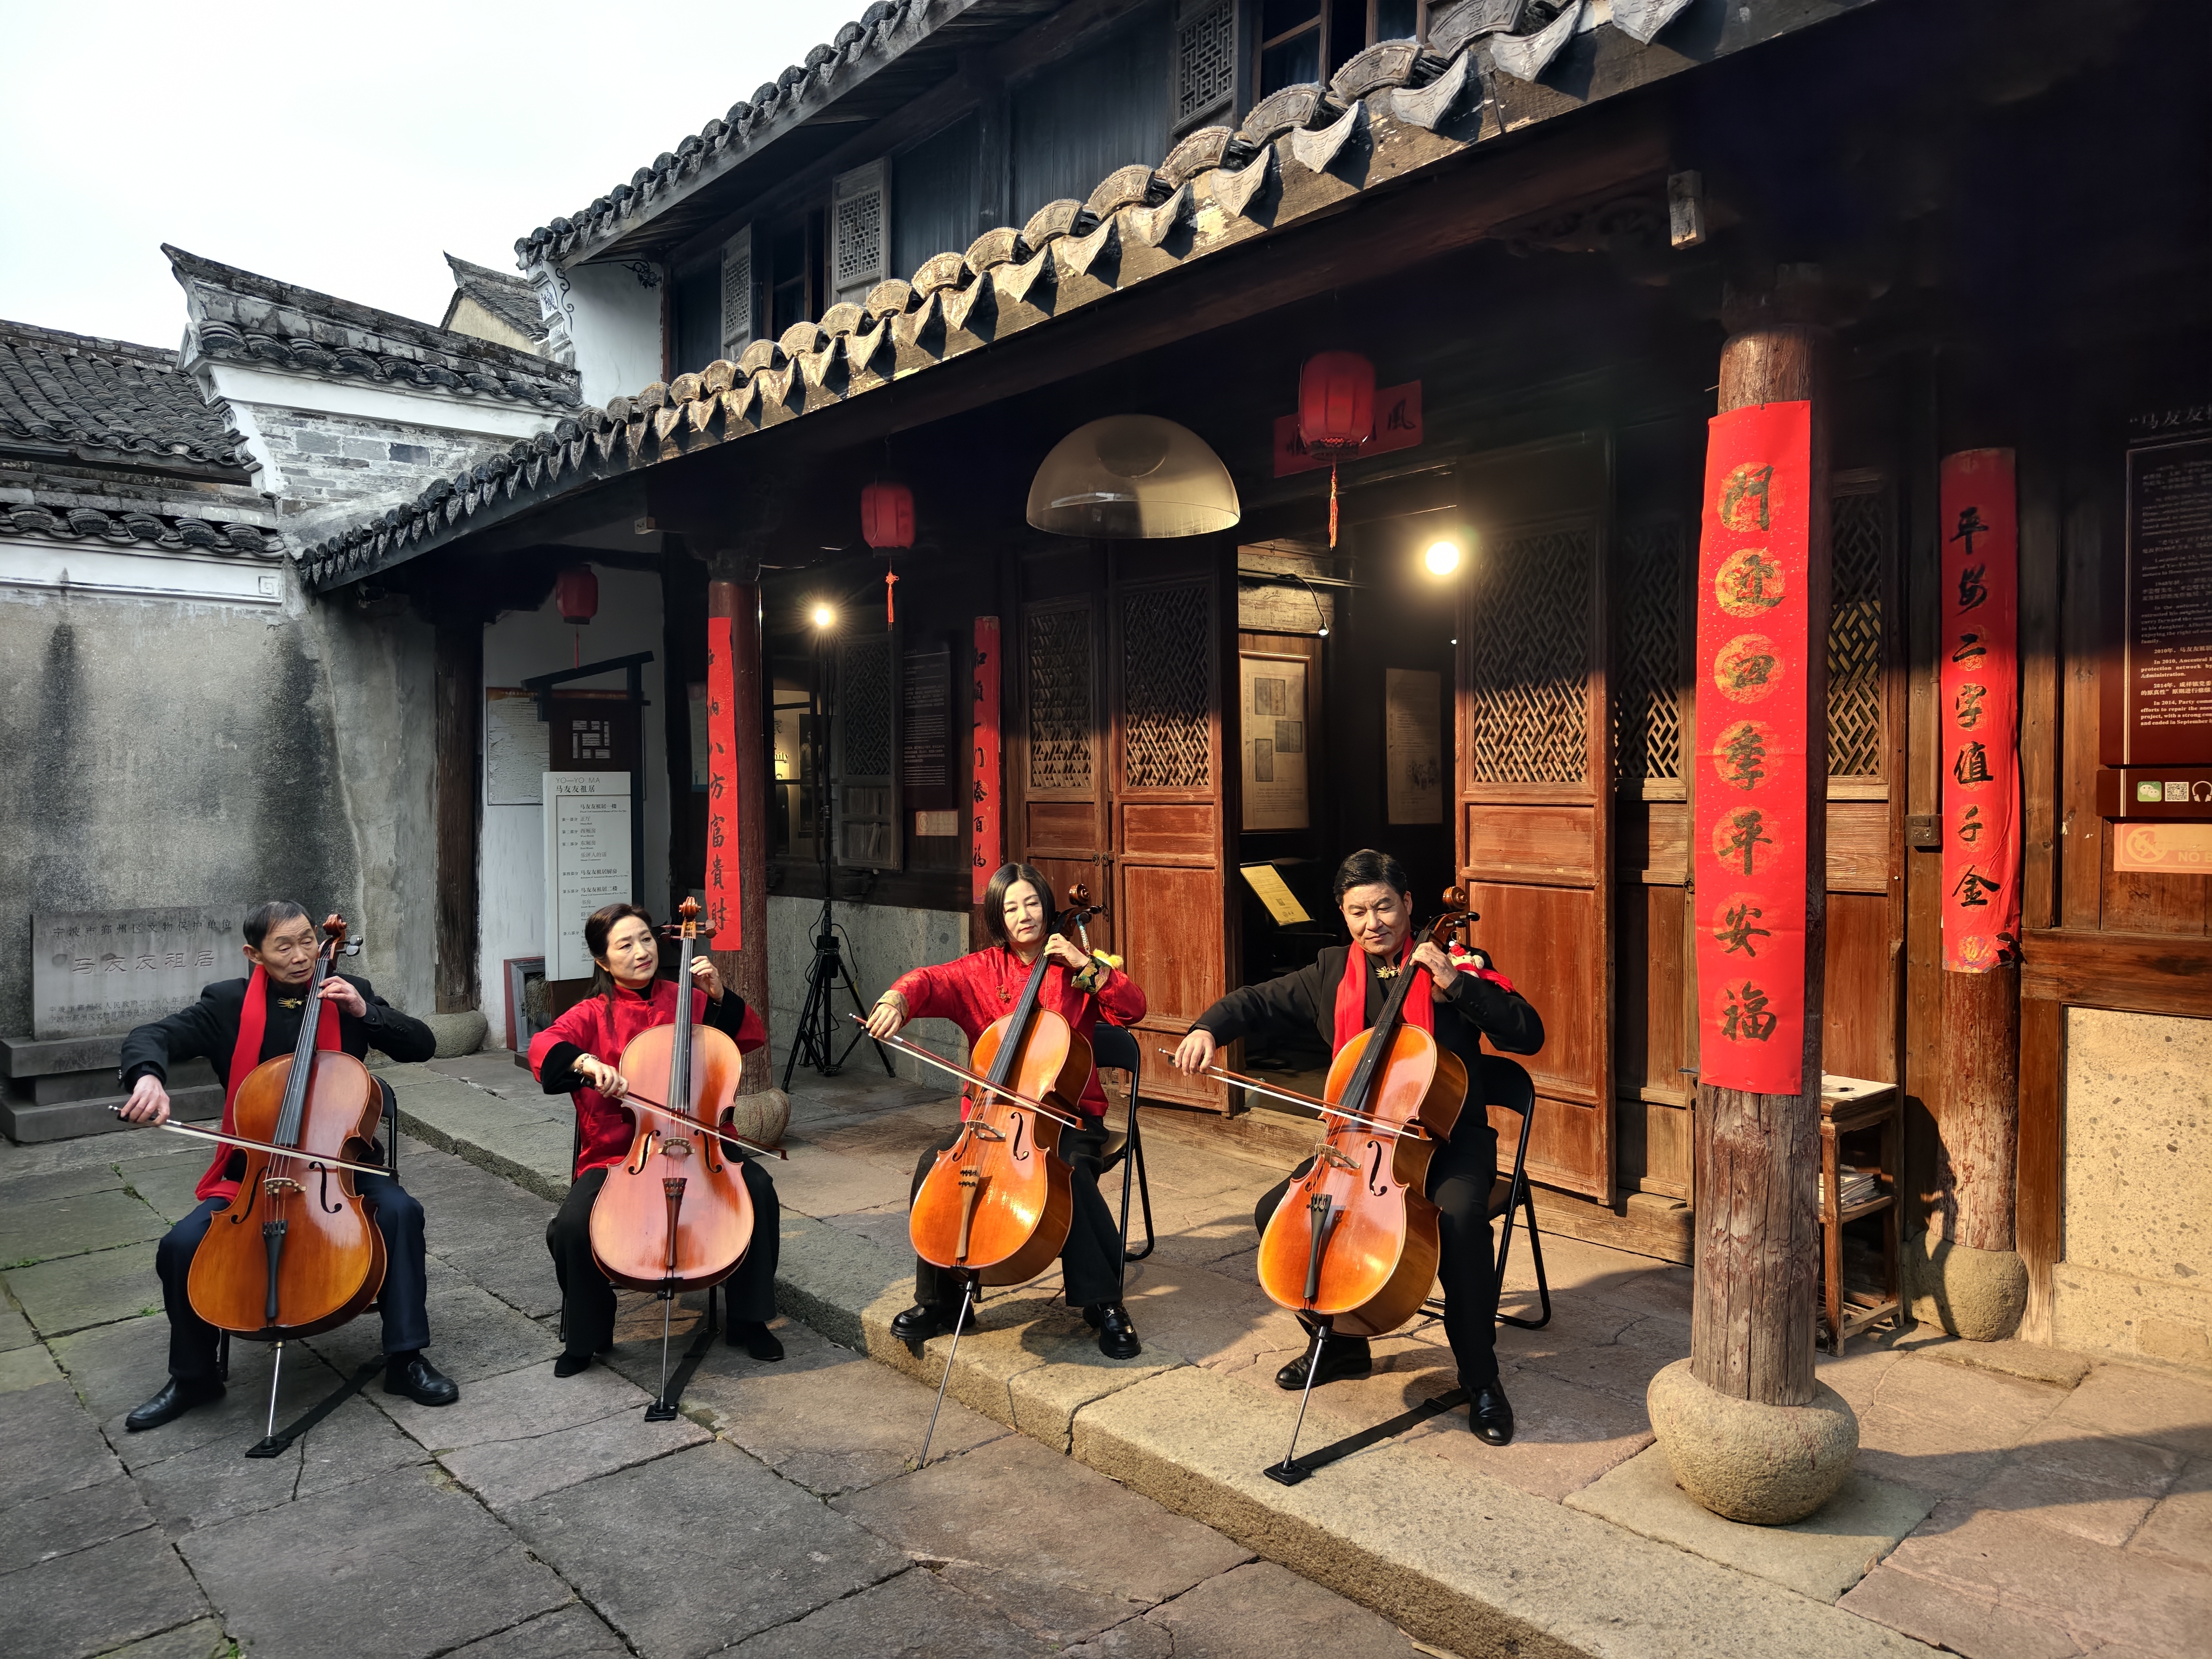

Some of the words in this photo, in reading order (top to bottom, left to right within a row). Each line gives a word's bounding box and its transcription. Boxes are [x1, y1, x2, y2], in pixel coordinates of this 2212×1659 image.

[556, 785, 595, 793] 马友友祖居
[2178, 851, 2200, 862] NO
[53, 919, 232, 938] 宁波市鄞州区文物保护单位
[72, 949, 215, 975] 马友友祖居
